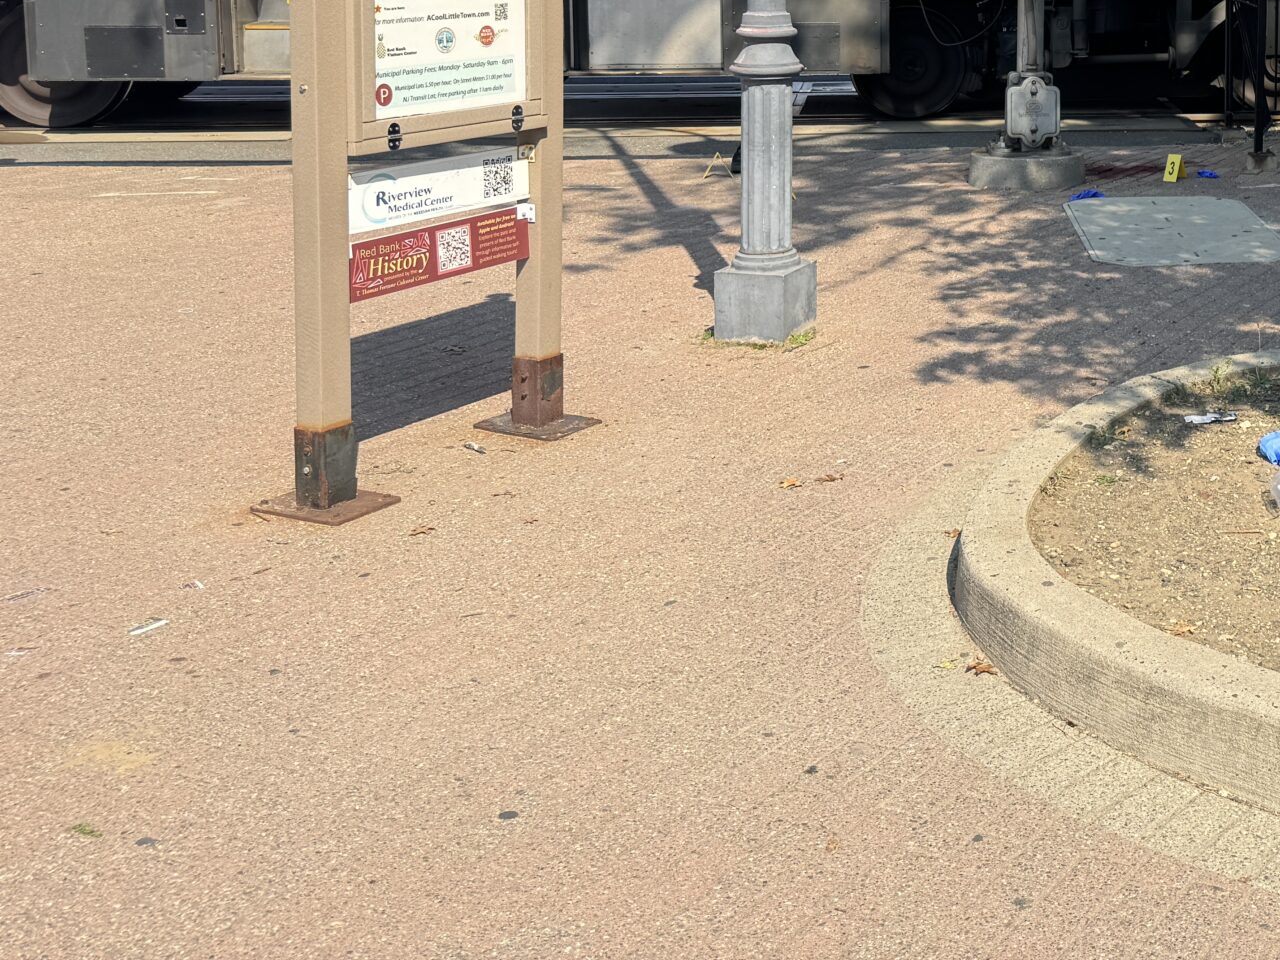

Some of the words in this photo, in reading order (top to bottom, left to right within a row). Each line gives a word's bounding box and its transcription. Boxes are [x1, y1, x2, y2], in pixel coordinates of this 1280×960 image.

[426, 11, 490, 21] ACoolLittleTown.com
[402, 67, 423, 77] Parking
[462, 60, 486, 71] Saturday
[502, 57, 514, 65] 6pm
[467, 86, 478, 94] after
[492, 83, 504, 91] daily
[1168, 161, 1176, 176] 3
[376, 187, 433, 206] Riverview
[388, 199, 423, 213] Medical
[424, 195, 454, 206] Center
[360, 246, 377, 259] Red
[379, 240, 401, 254] Bank
[368, 251, 430, 279] History
[362, 286, 379, 296] Thomas
[396, 276, 415, 286] Cultural
[415, 273, 430, 282] Center
